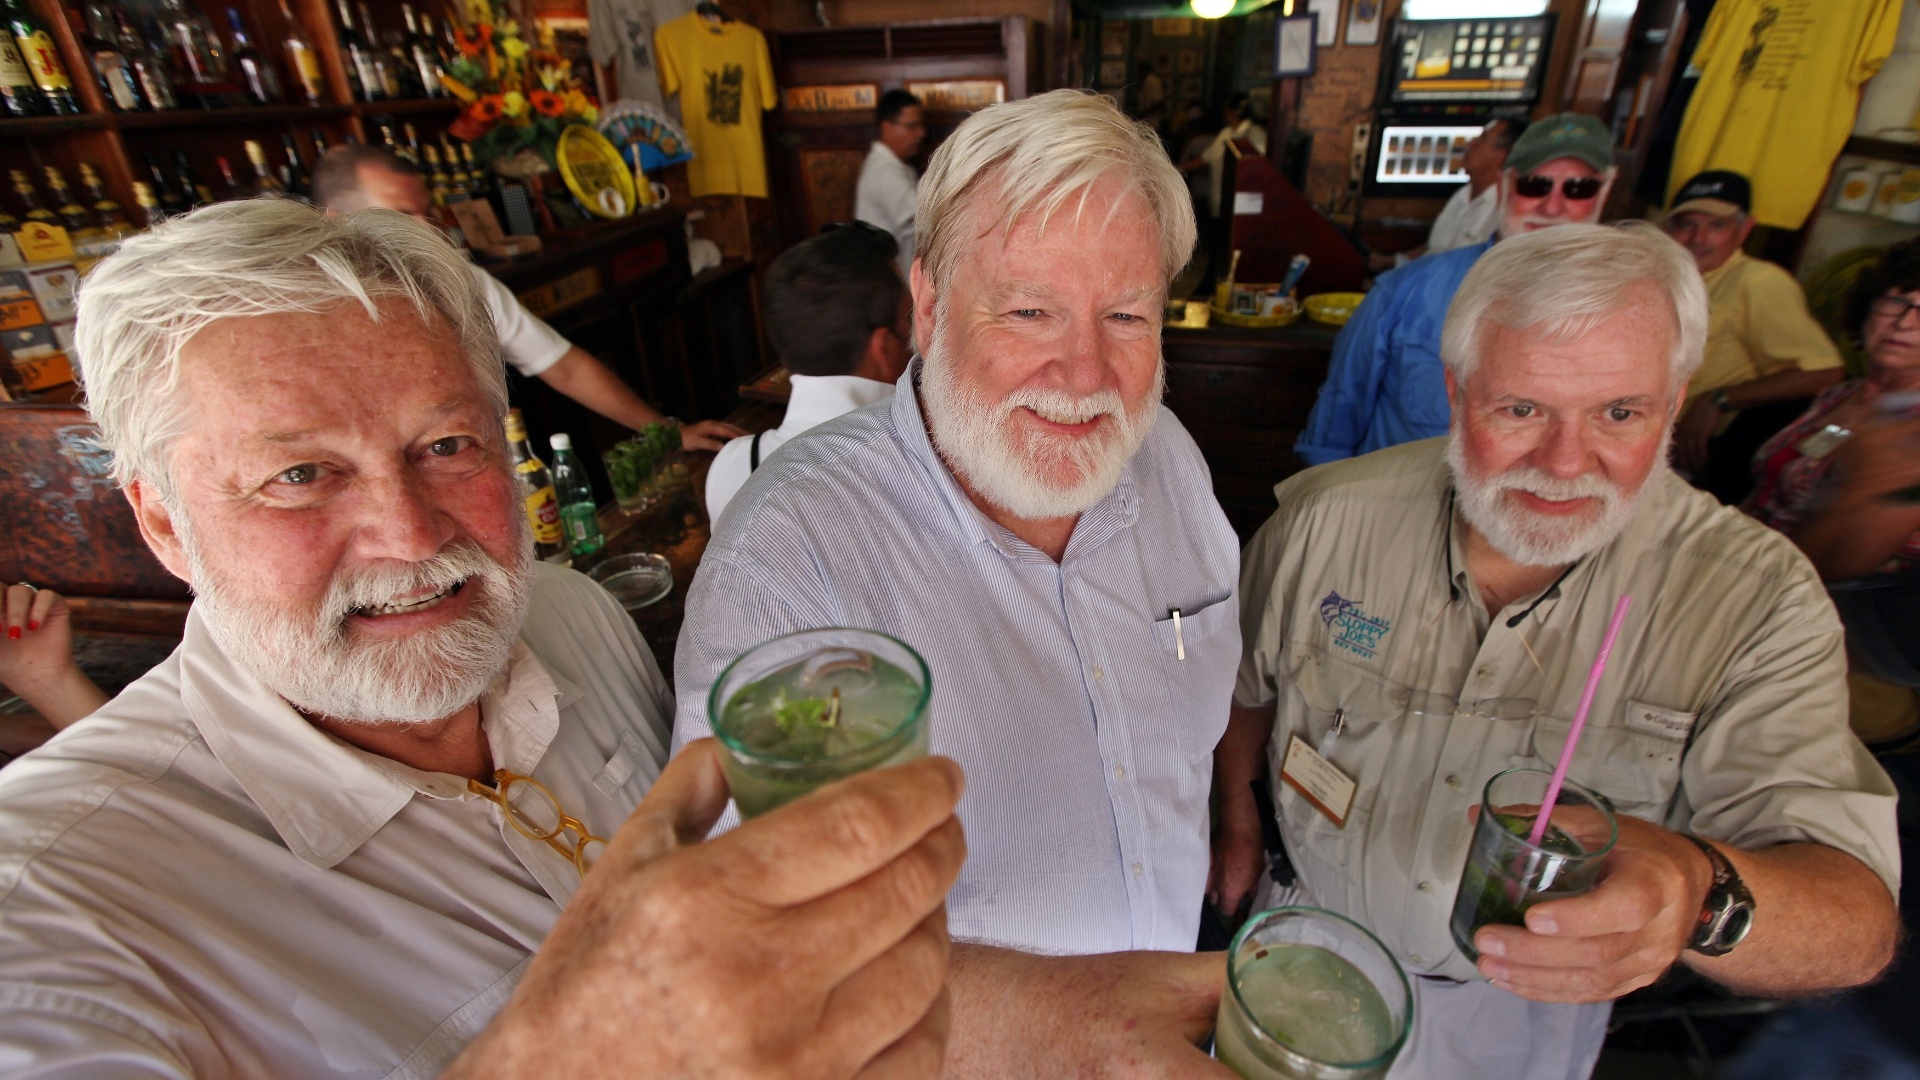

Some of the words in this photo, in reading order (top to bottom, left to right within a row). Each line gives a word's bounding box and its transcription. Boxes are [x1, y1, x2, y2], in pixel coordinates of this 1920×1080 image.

[1335, 612, 1391, 639] SLOPPY
[1339, 620, 1376, 649] JOE'S
[1334, 638, 1350, 650] KEY
[1352, 645, 1373, 659] WEST
